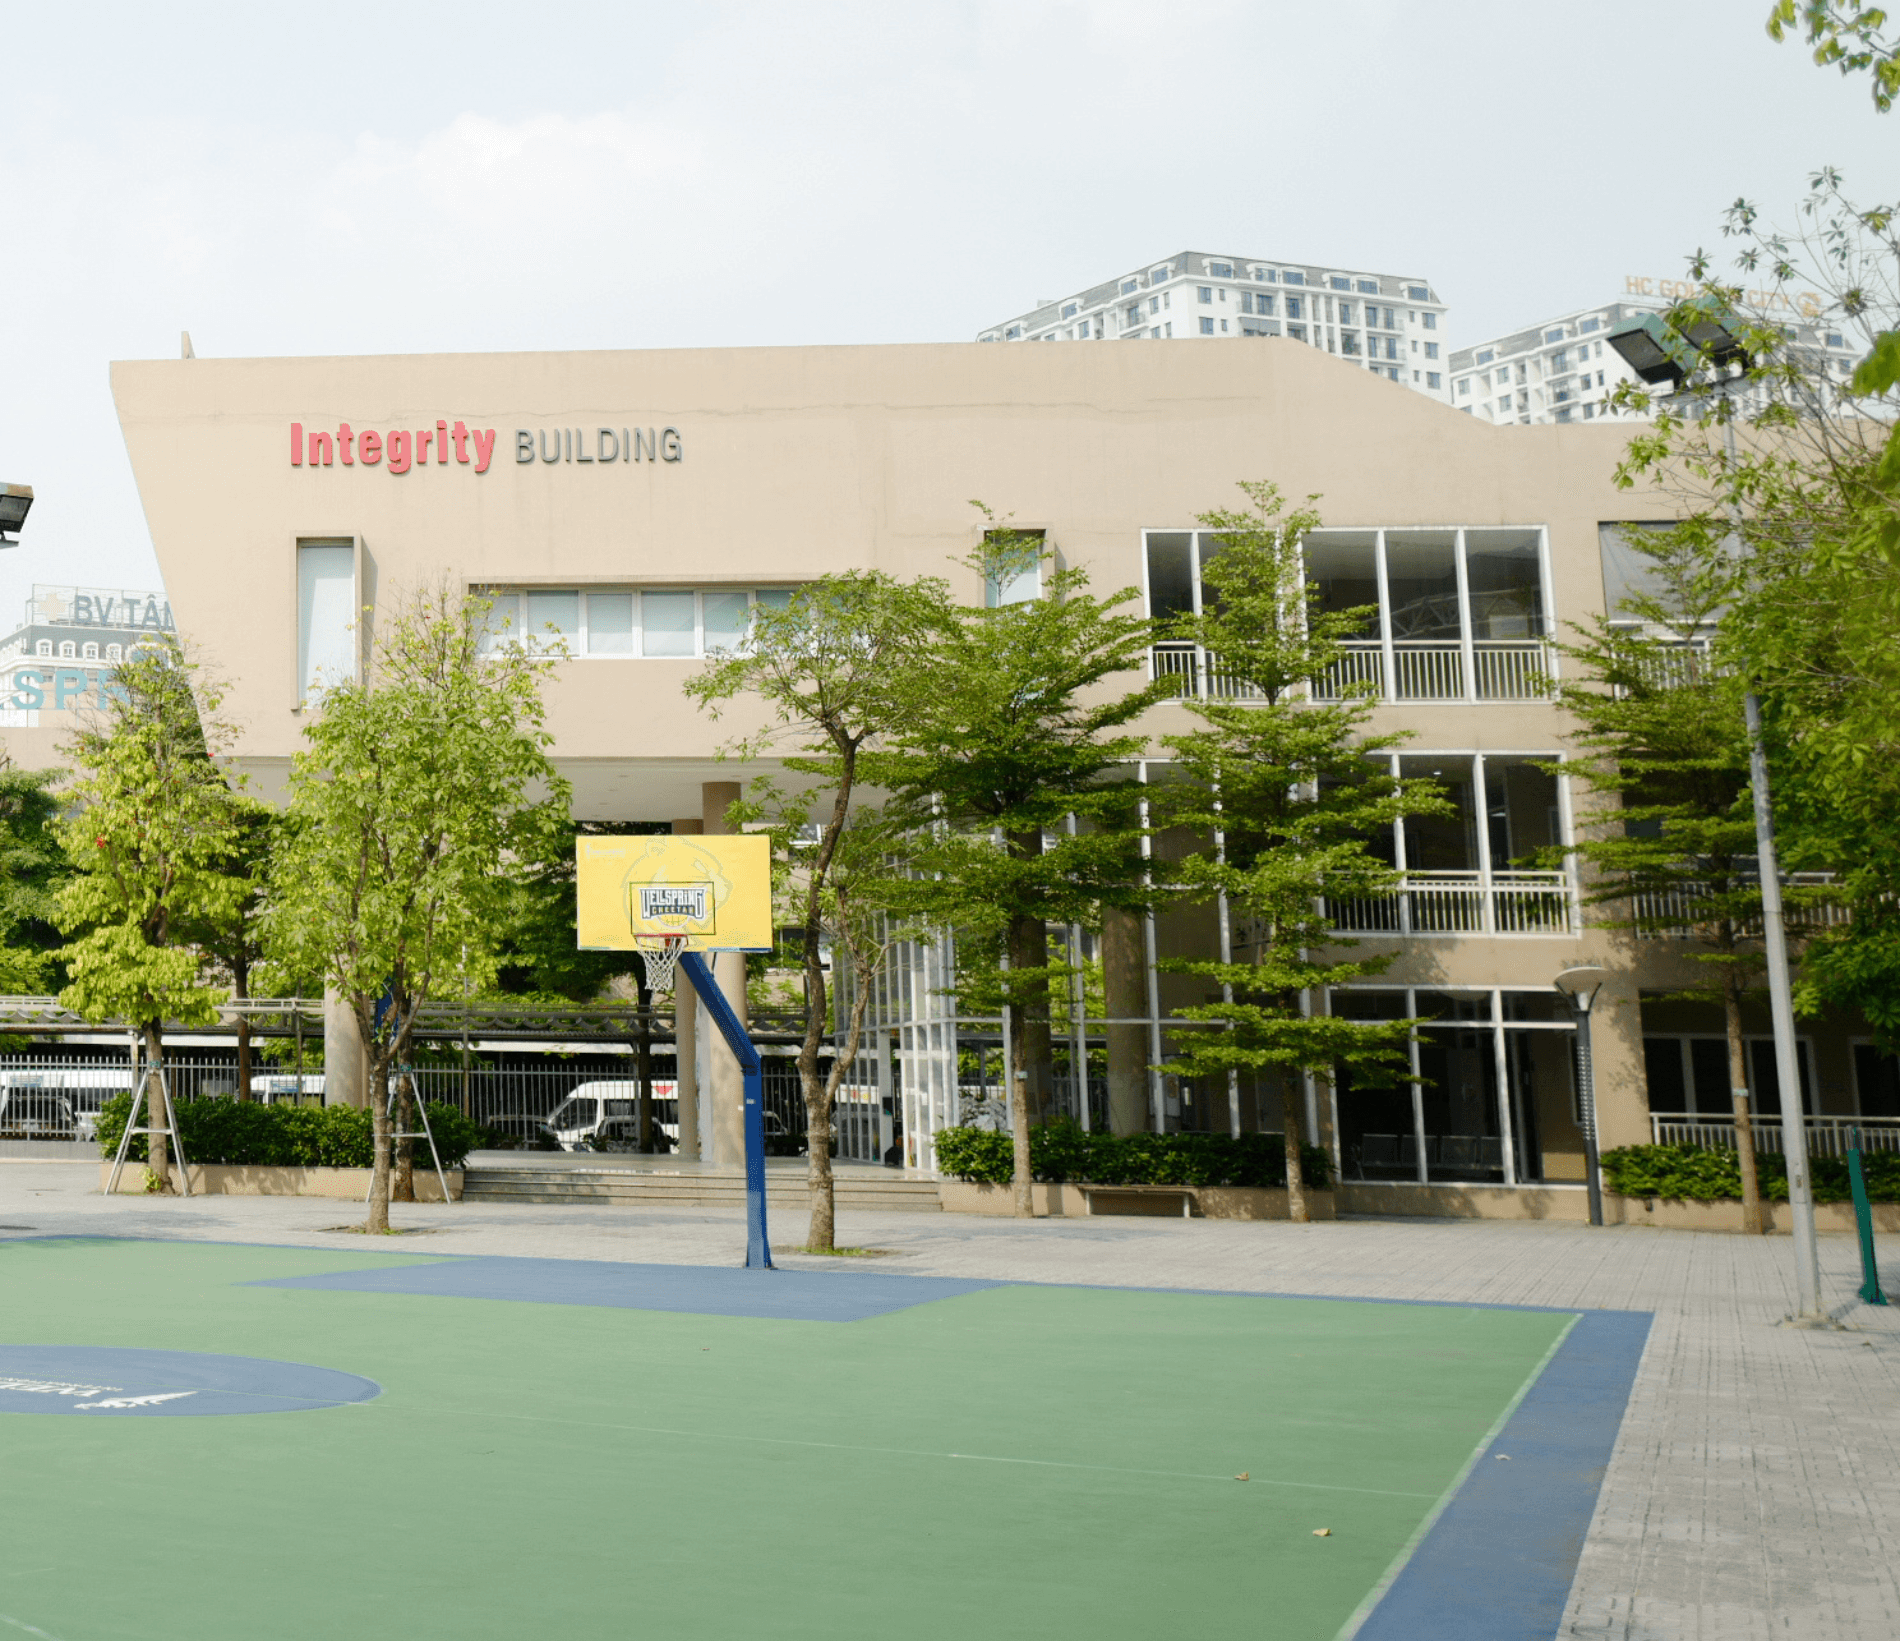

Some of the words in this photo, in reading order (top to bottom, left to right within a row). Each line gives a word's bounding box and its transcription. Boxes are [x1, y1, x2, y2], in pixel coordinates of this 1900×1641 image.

[1625, 275, 1653, 295] HC
[1747, 289, 1789, 311] CITY
[290, 419, 497, 473] Integrity
[515, 426, 683, 464] BUILDING
[74, 595, 114, 627] BV
